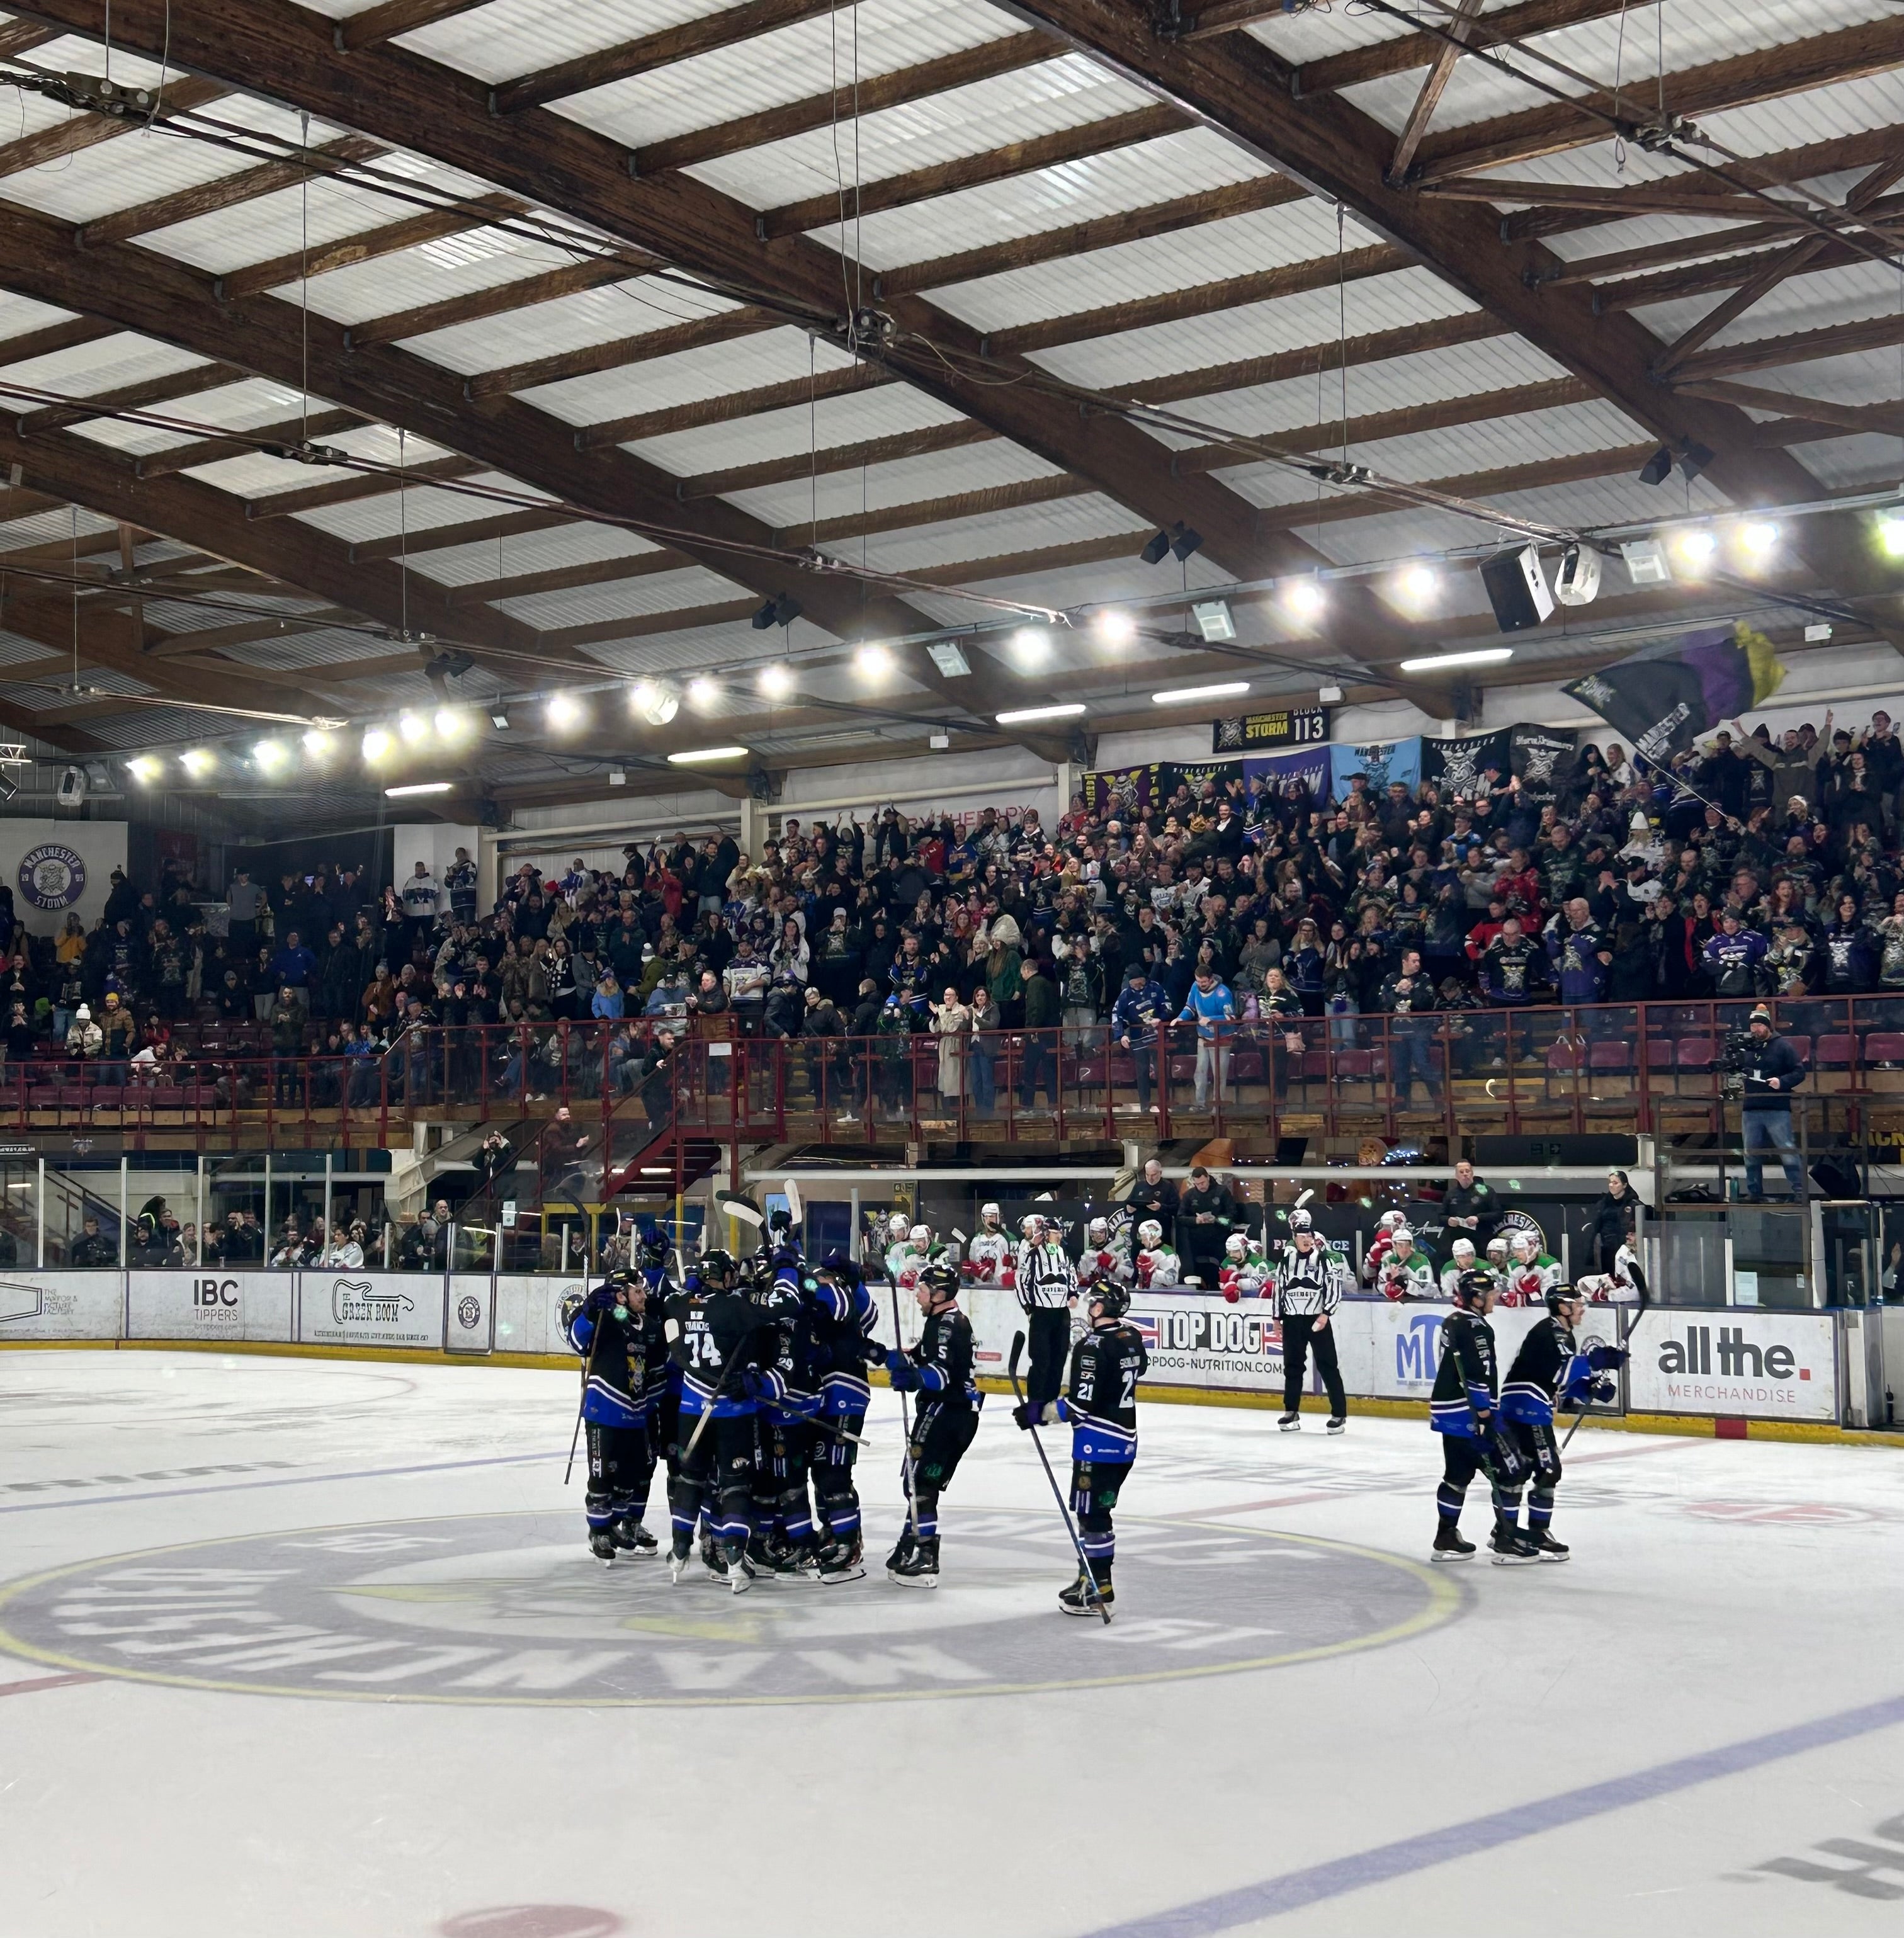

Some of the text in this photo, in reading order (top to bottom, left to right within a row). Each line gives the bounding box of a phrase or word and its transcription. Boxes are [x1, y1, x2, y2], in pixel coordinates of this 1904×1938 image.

[1245, 720, 1288, 739] STORM
[1295, 716, 1323, 741] 113
[24, 847, 81, 869] MANCHESTER
[194, 1279, 239, 1306] IBC
[194, 1308, 238, 1321] TIPPERS
[1162, 1312, 1262, 1354] TOP DOG
[684, 1332, 722, 1368] 74
[938, 1346, 948, 1359] 5
[1077, 1383, 1094, 1402] 21
[1668, 1385, 1796, 1403] MERCHANDISE
